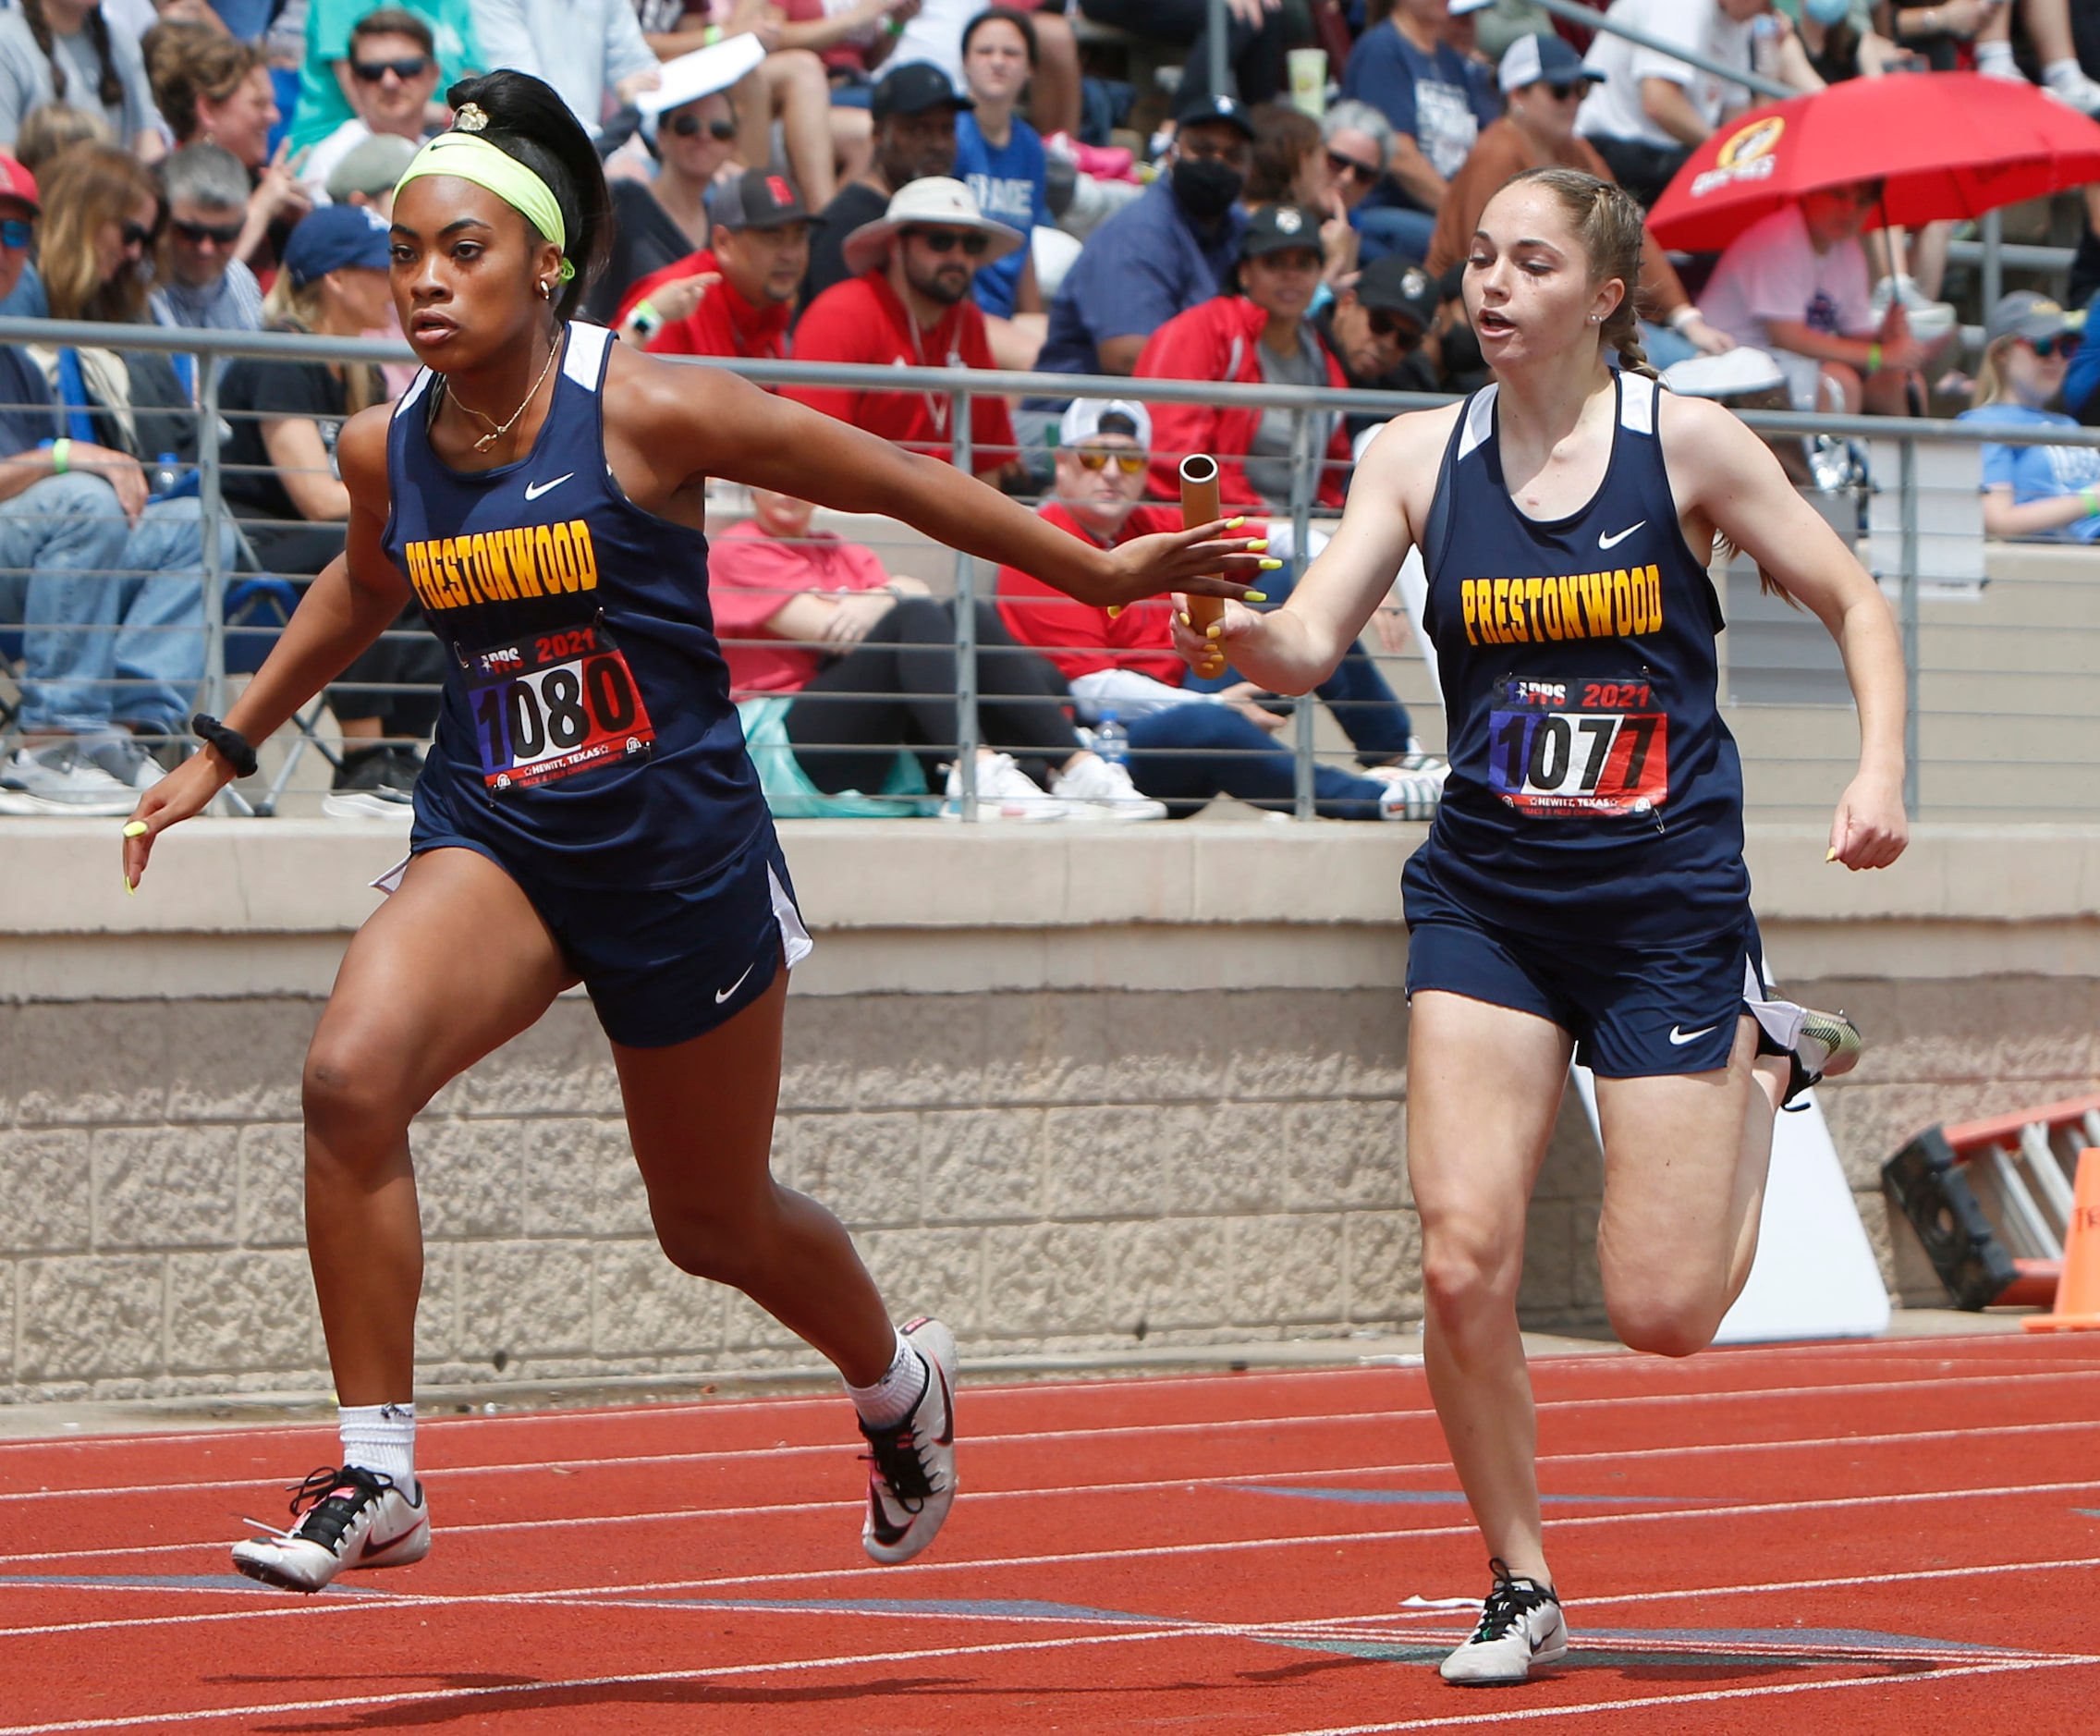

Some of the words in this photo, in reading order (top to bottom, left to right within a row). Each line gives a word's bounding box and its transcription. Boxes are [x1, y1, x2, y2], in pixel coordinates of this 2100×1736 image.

[405, 520, 598, 610] PRESTONWOOD
[1461, 564, 1662, 645] PRESTONWOOD
[535, 628, 595, 664] 2021
[478, 657, 636, 766] 1080
[1506, 681, 1567, 705] TAPPS
[1581, 684, 1649, 707] 2021
[531, 761, 567, 775] HEWITT,
[567, 747, 601, 764] TEXAS
[1498, 715, 1658, 789] 1077
[1577, 798, 1610, 807] TEXAS
